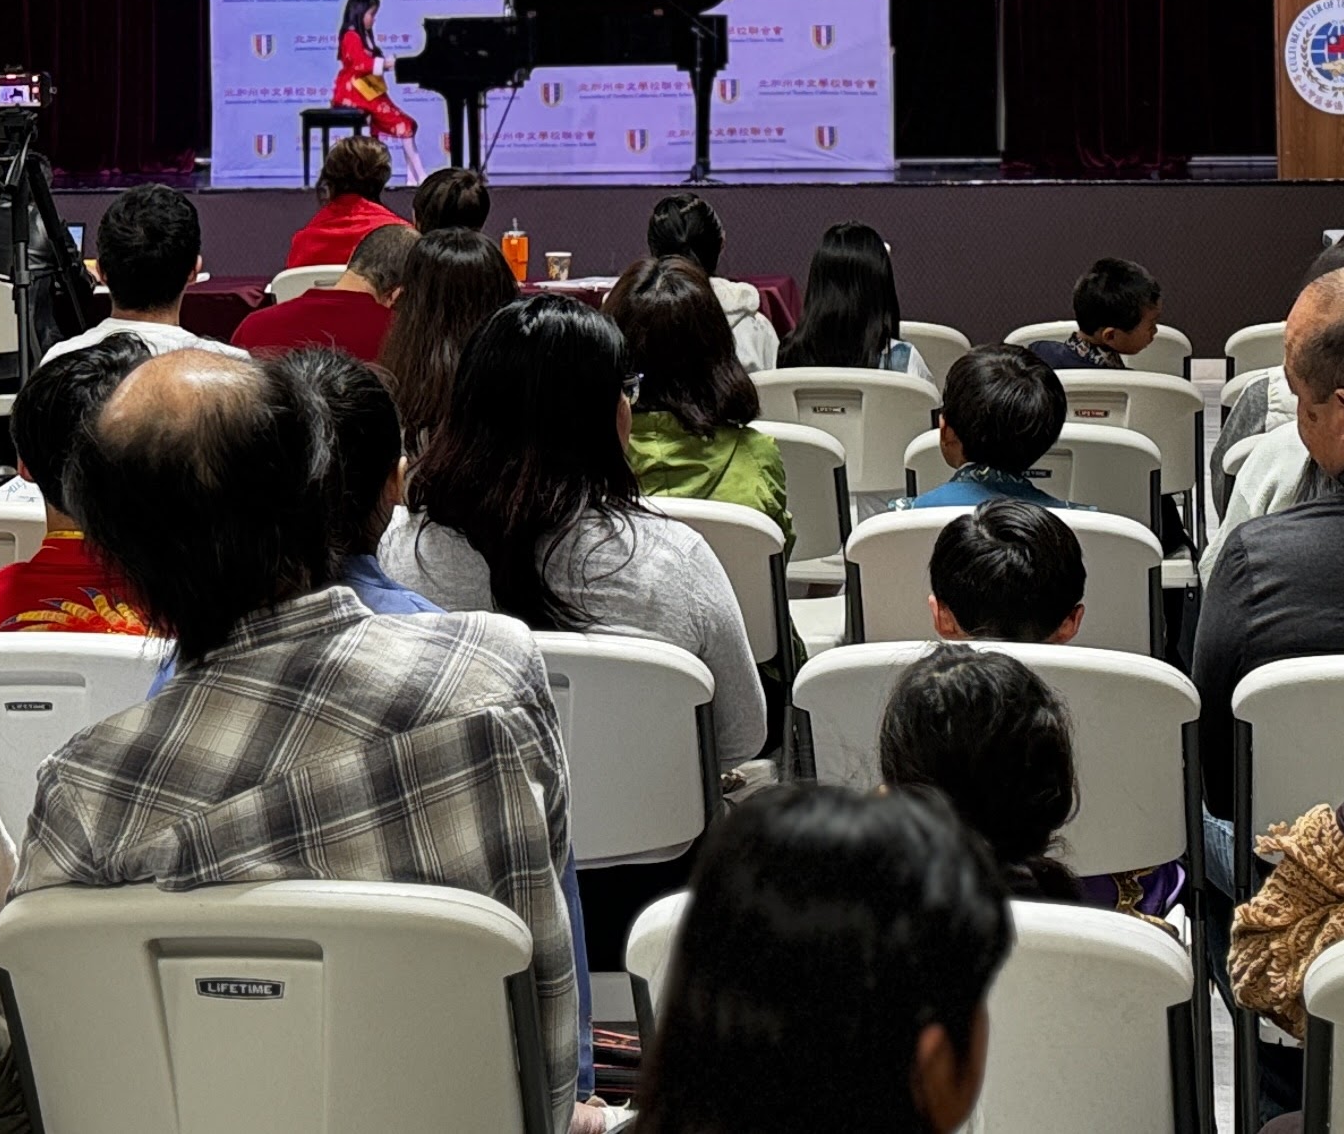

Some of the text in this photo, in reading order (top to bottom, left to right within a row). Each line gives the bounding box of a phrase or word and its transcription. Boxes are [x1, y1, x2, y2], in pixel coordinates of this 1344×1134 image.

[1297, 4, 1323, 32] CENTER
[1323, 0, 1334, 10] OF
[208, 982, 273, 995] LIFETIME
